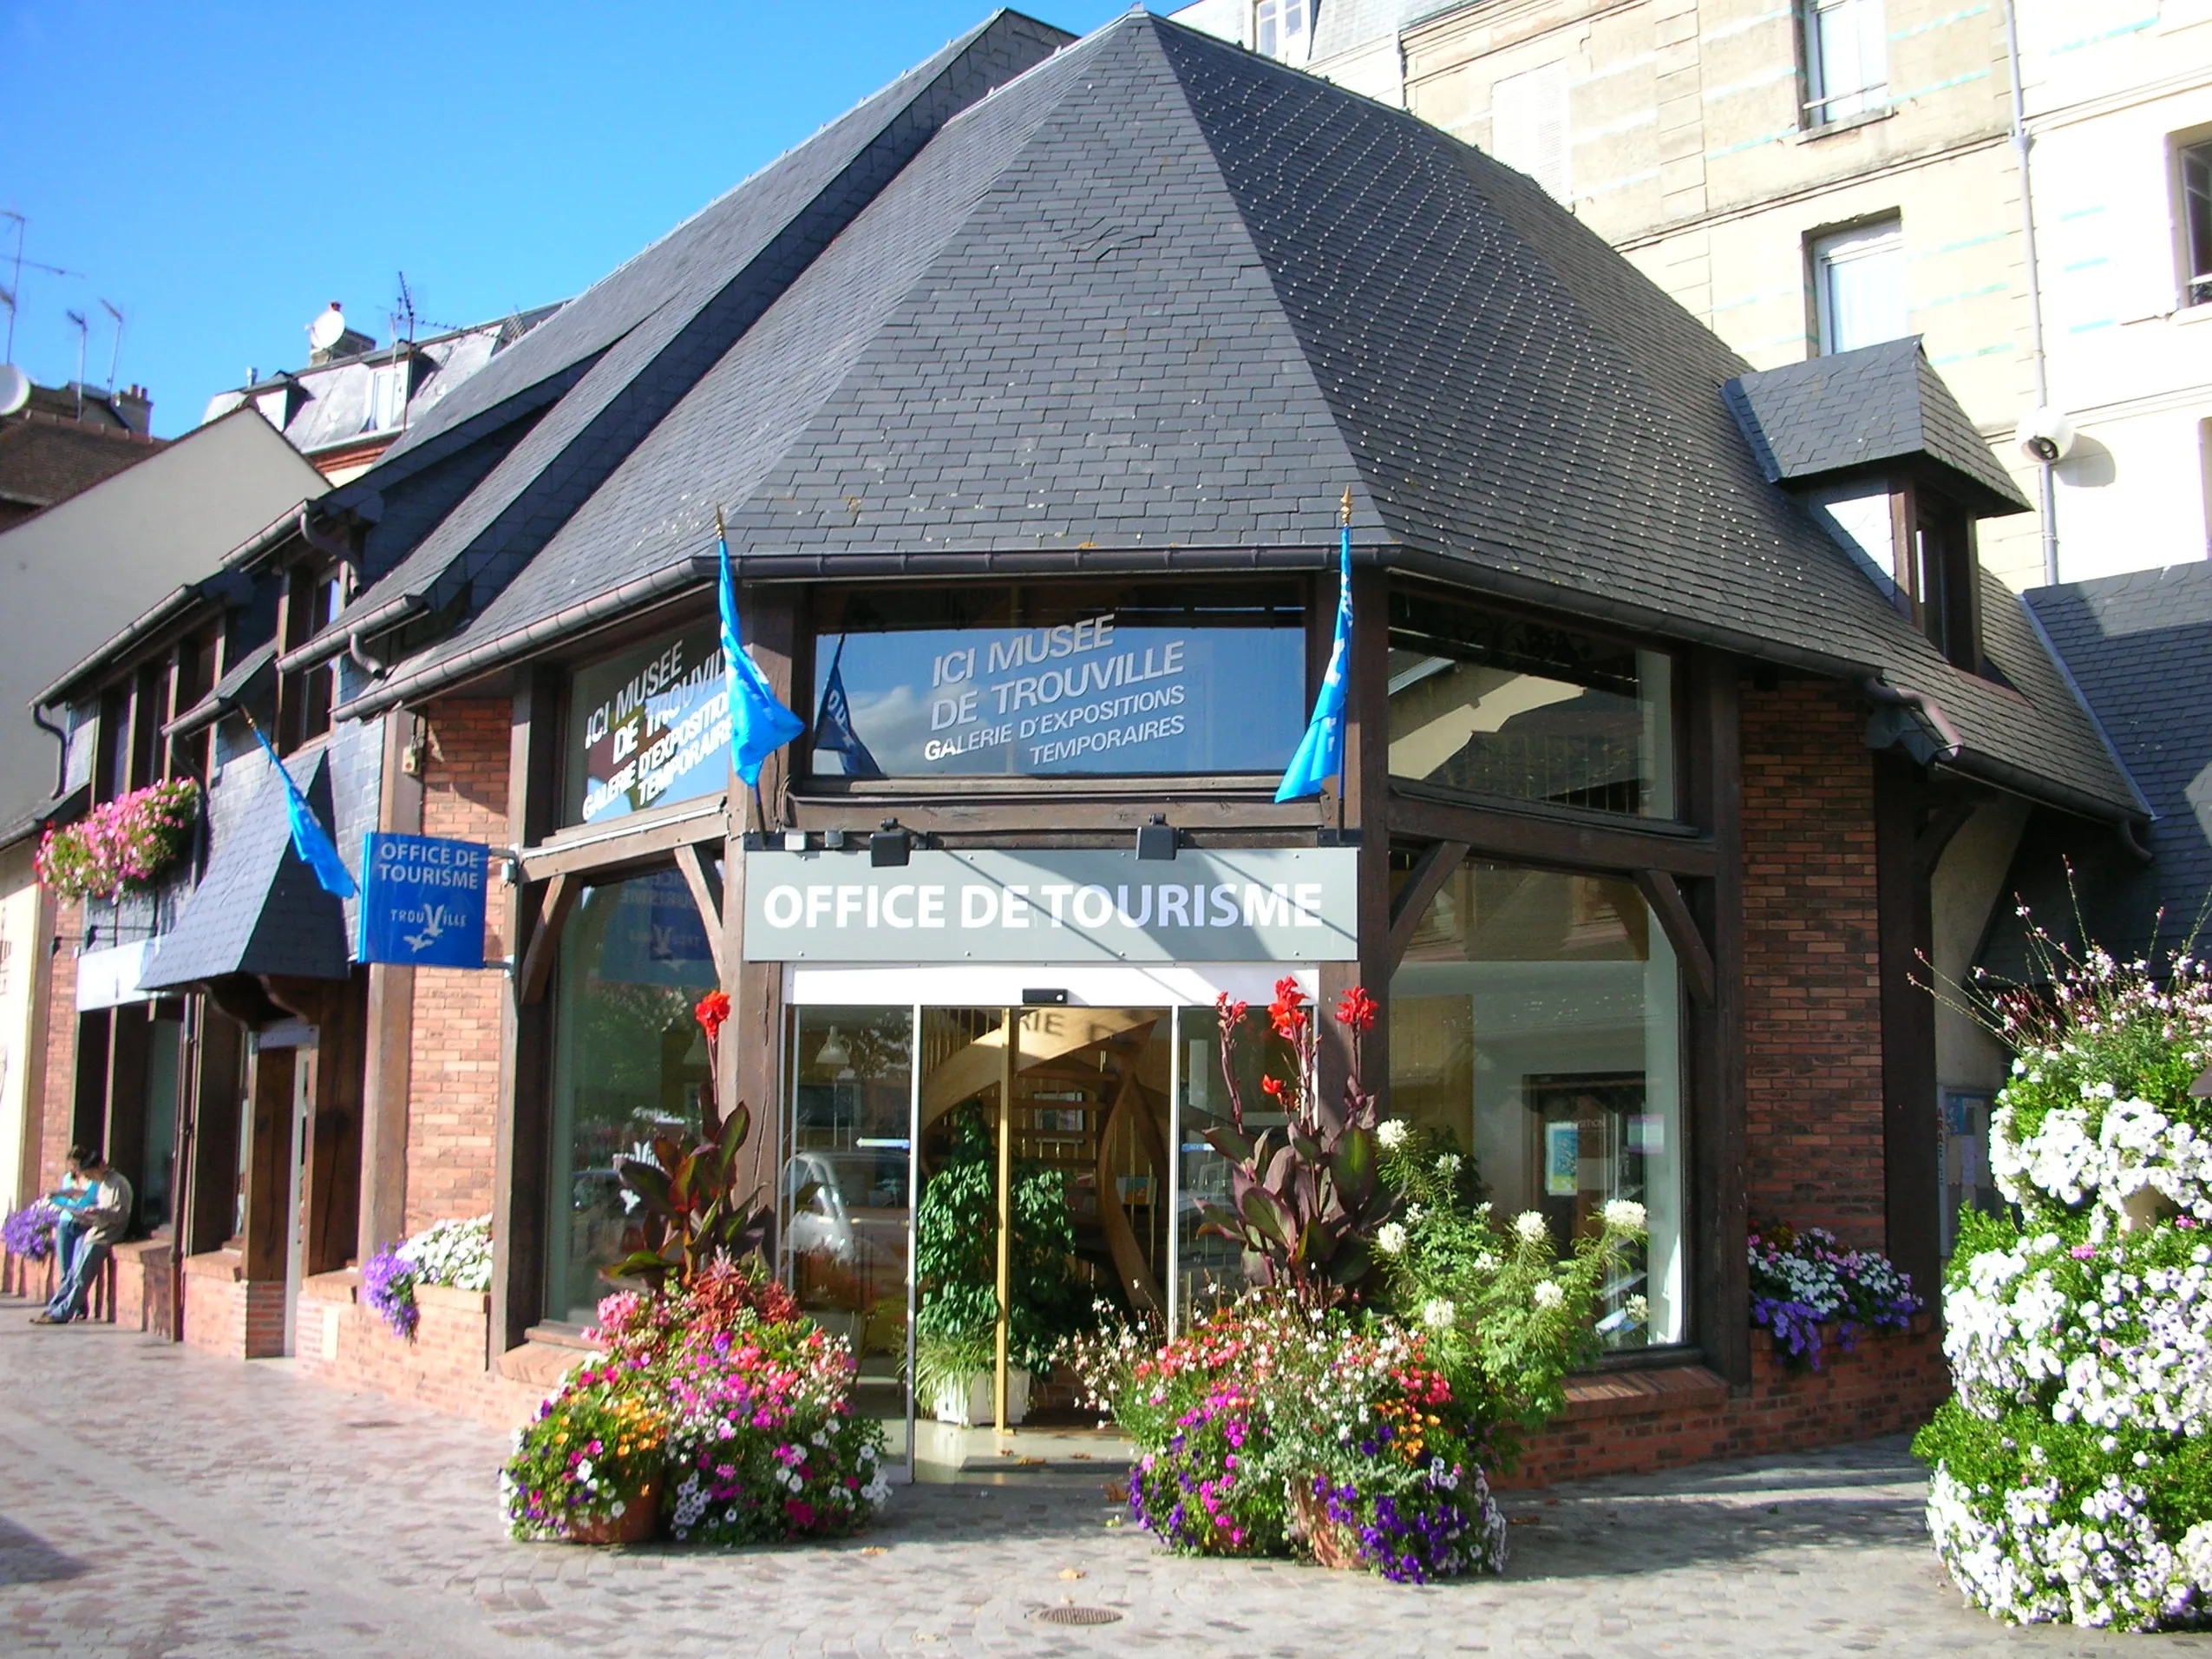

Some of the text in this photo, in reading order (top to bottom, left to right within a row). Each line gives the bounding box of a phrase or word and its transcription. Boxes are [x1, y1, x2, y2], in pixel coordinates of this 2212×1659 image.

[931, 640, 1185, 731] DE TROUVILLE
[933, 613, 1116, 688] ICI MUSEE
[585, 700, 610, 750] ICI
[615, 639, 684, 725] MUSEE
[612, 715, 639, 765] DE
[644, 648, 727, 738] TROUVIL
[924, 685, 1186, 762] GALERIE D'EXPOSITIONS
[581, 692, 730, 822] GALERIE D'EXPOSITIO
[637, 713, 733, 806] TEMPORAIRE
[1030, 714, 1186, 766] TEMPORAIRES
[379, 862, 480, 890] TOURISME
[382, 842, 480, 869] OFFICE DE
[763, 882, 1324, 928] OFFICE DE TOURISME
